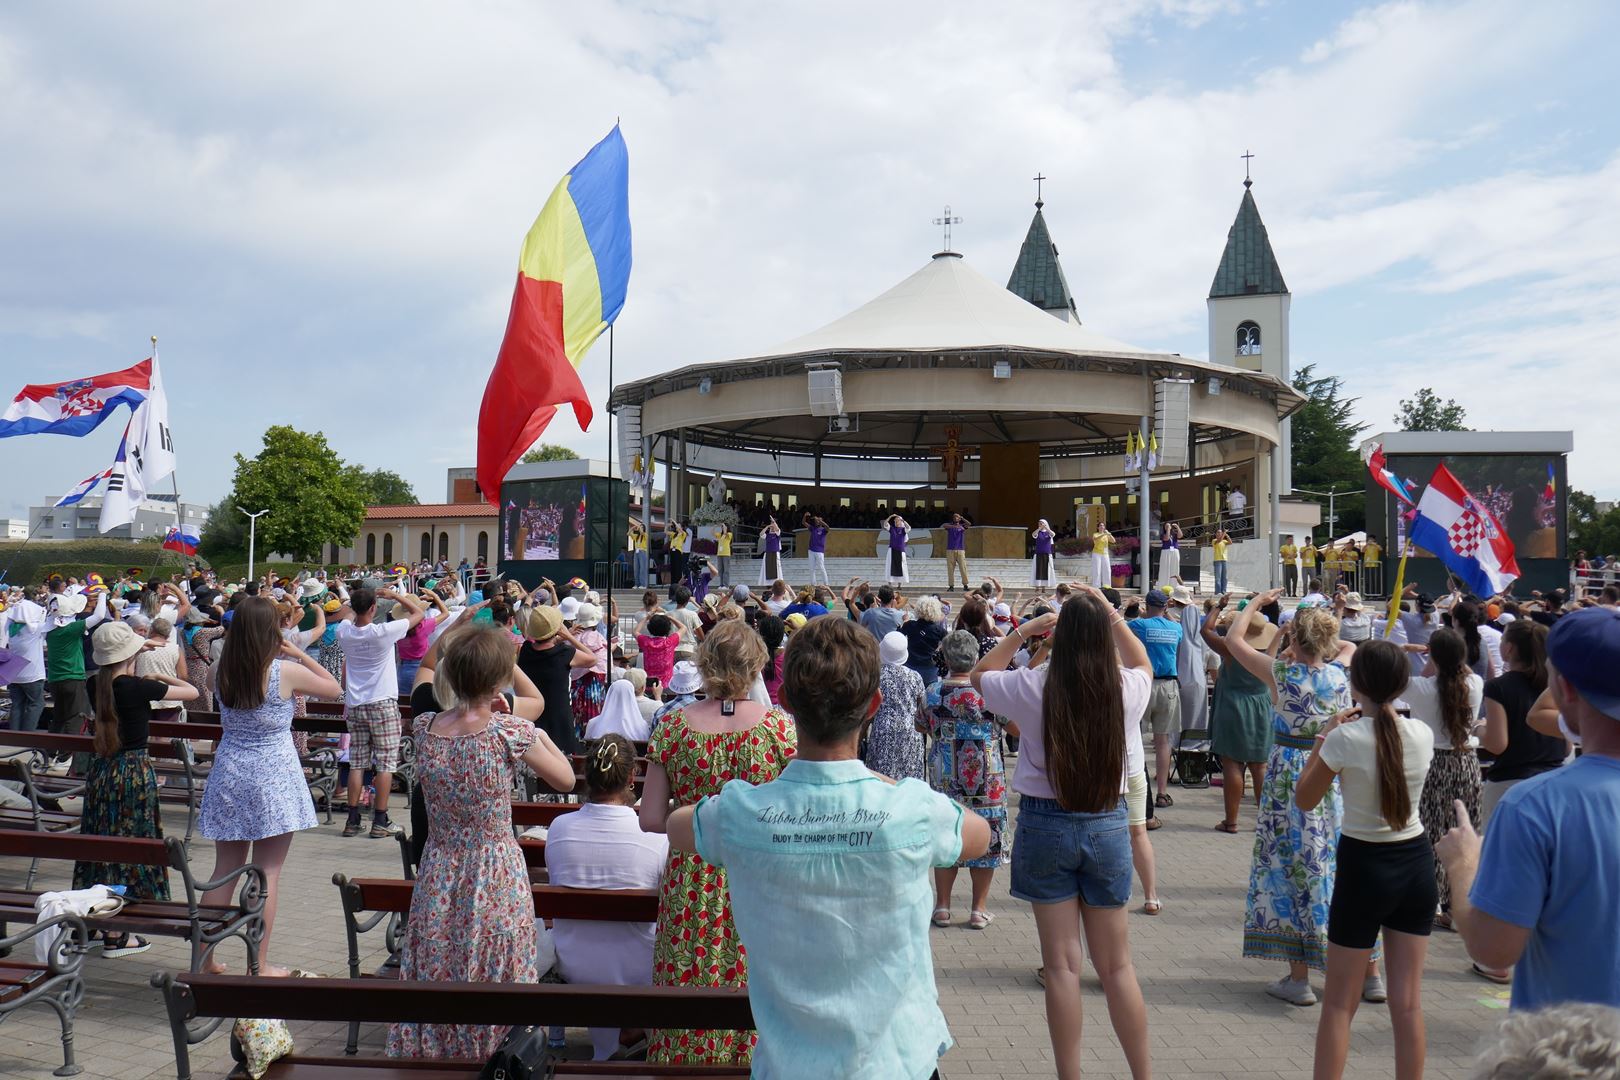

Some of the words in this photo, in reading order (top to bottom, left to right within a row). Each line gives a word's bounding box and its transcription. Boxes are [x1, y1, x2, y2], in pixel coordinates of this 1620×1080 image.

[757, 805, 798, 824] Lisbon
[799, 808, 847, 825] Summer
[849, 808, 892, 828] Breeze
[772, 833, 792, 843] ENJOY
[804, 833, 826, 843] CHARM
[828, 833, 836, 842] OF
[837, 833, 848, 842] THE
[849, 831, 873, 847] CITY
